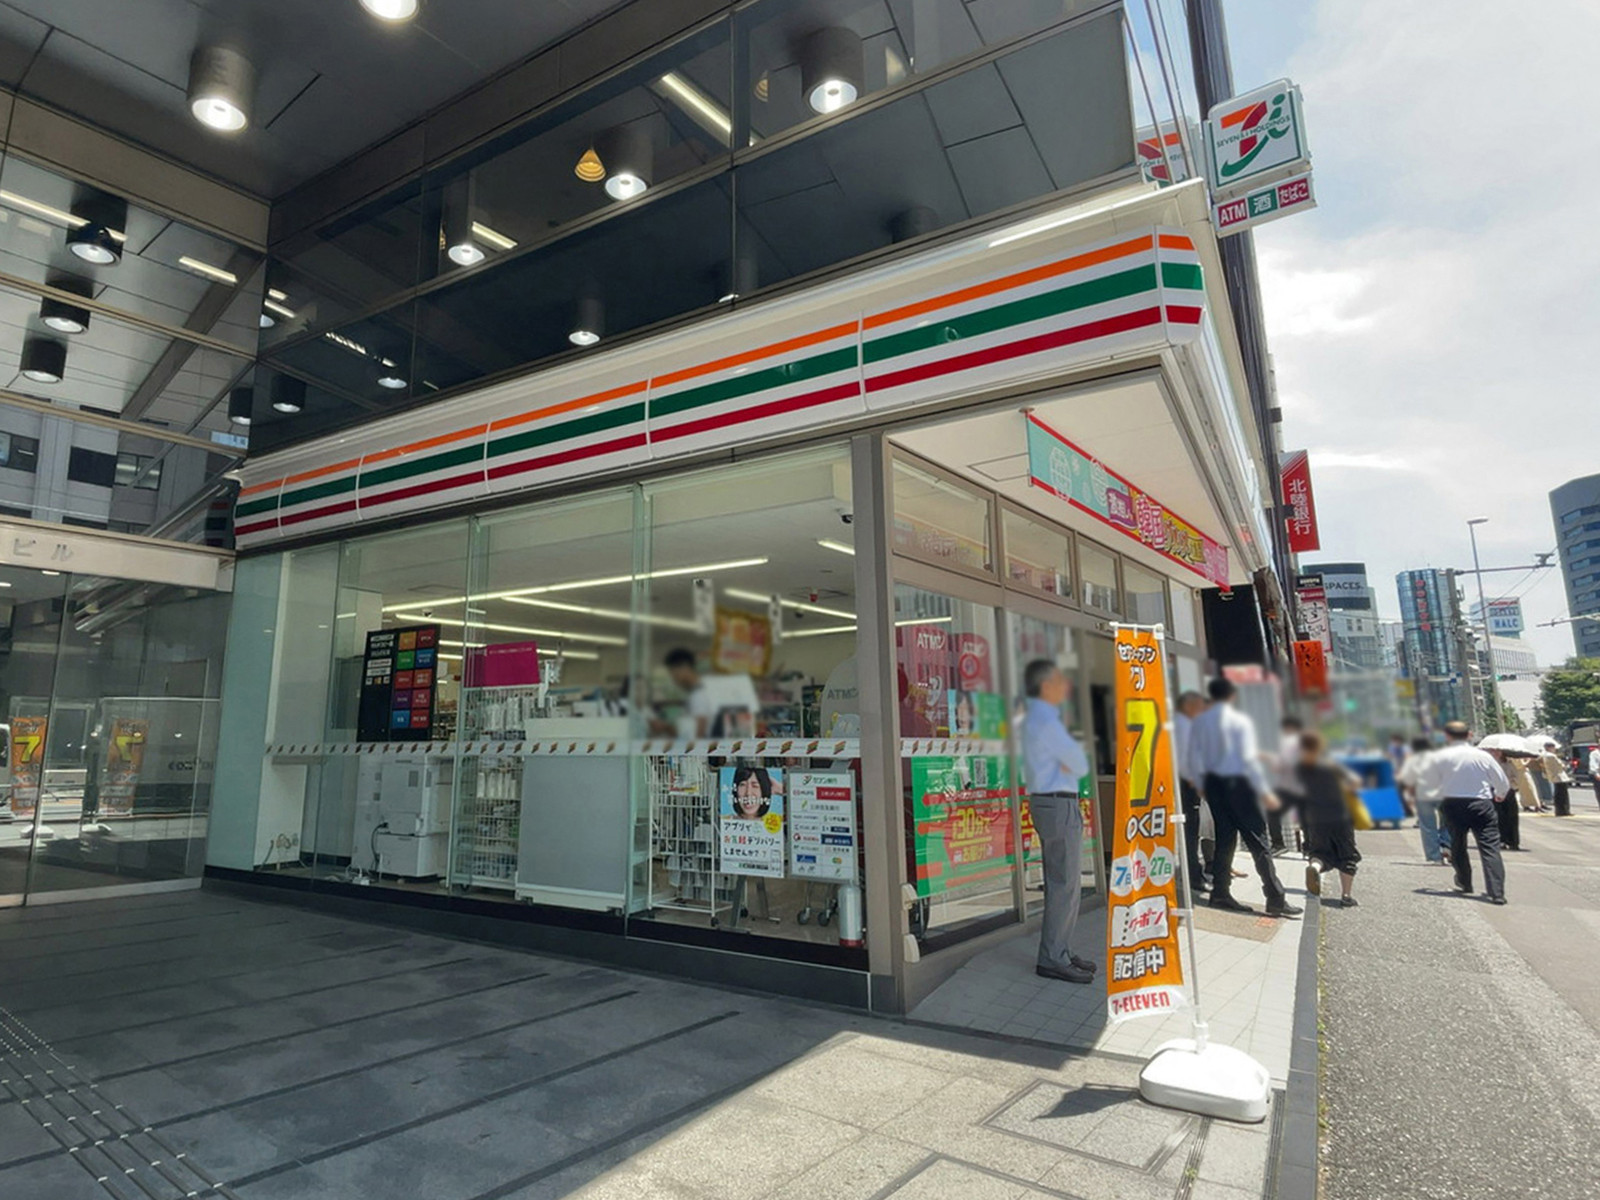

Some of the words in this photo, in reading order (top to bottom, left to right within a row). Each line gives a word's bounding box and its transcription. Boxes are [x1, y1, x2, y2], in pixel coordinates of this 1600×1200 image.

[1249, 114, 1291, 136] HOLDINGS
[1253, 192, 1272, 214] 酒
[1279, 181, 1308, 204] たばこ
[1220, 202, 1246, 224] ATM
[917, 632, 941, 651] ATM
[827, 688, 853, 700] ATM
[1126, 699, 1160, 807] 7
[1150, 857, 1172, 877] 27日
[1113, 945, 1166, 981] 配信中
